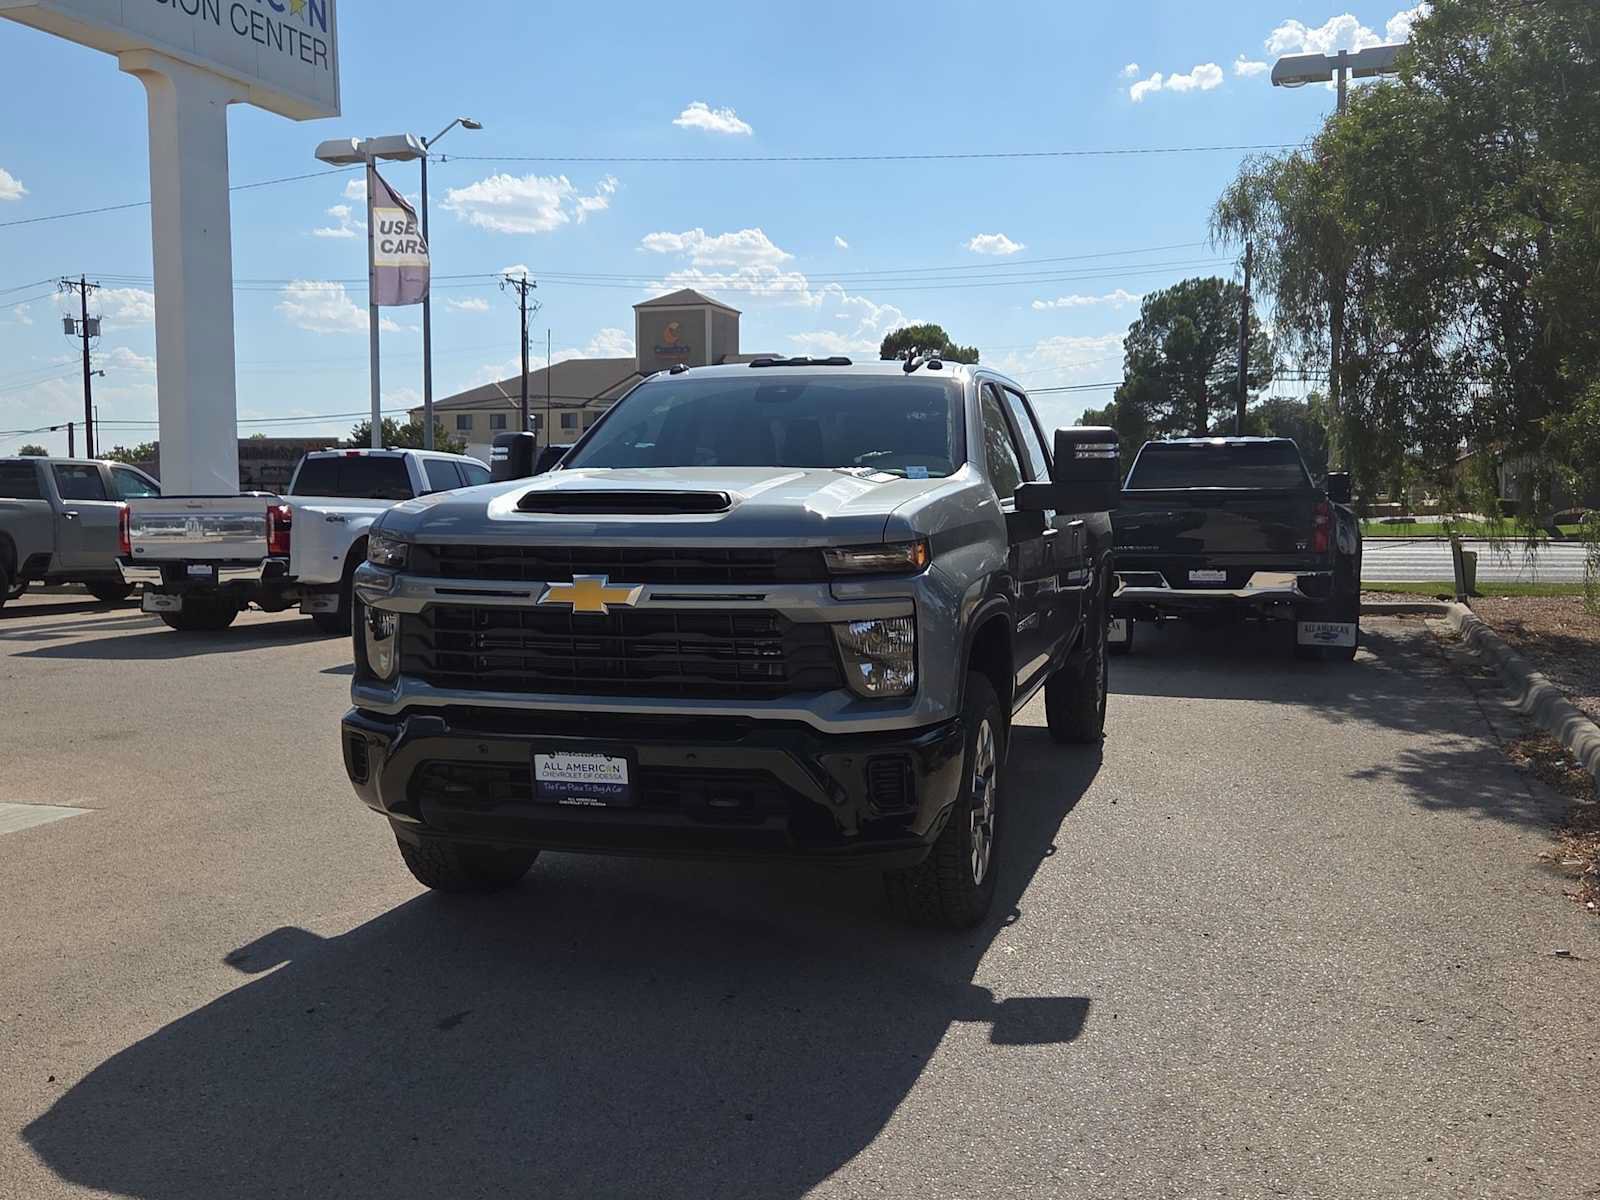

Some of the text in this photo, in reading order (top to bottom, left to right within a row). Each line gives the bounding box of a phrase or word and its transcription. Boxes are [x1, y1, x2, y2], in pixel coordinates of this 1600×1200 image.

[230, 3, 328, 71] CENTER
[380, 239, 427, 254] CARS
[543, 761, 563, 771] ALL
[542, 771, 582, 779] CHEVROLET
